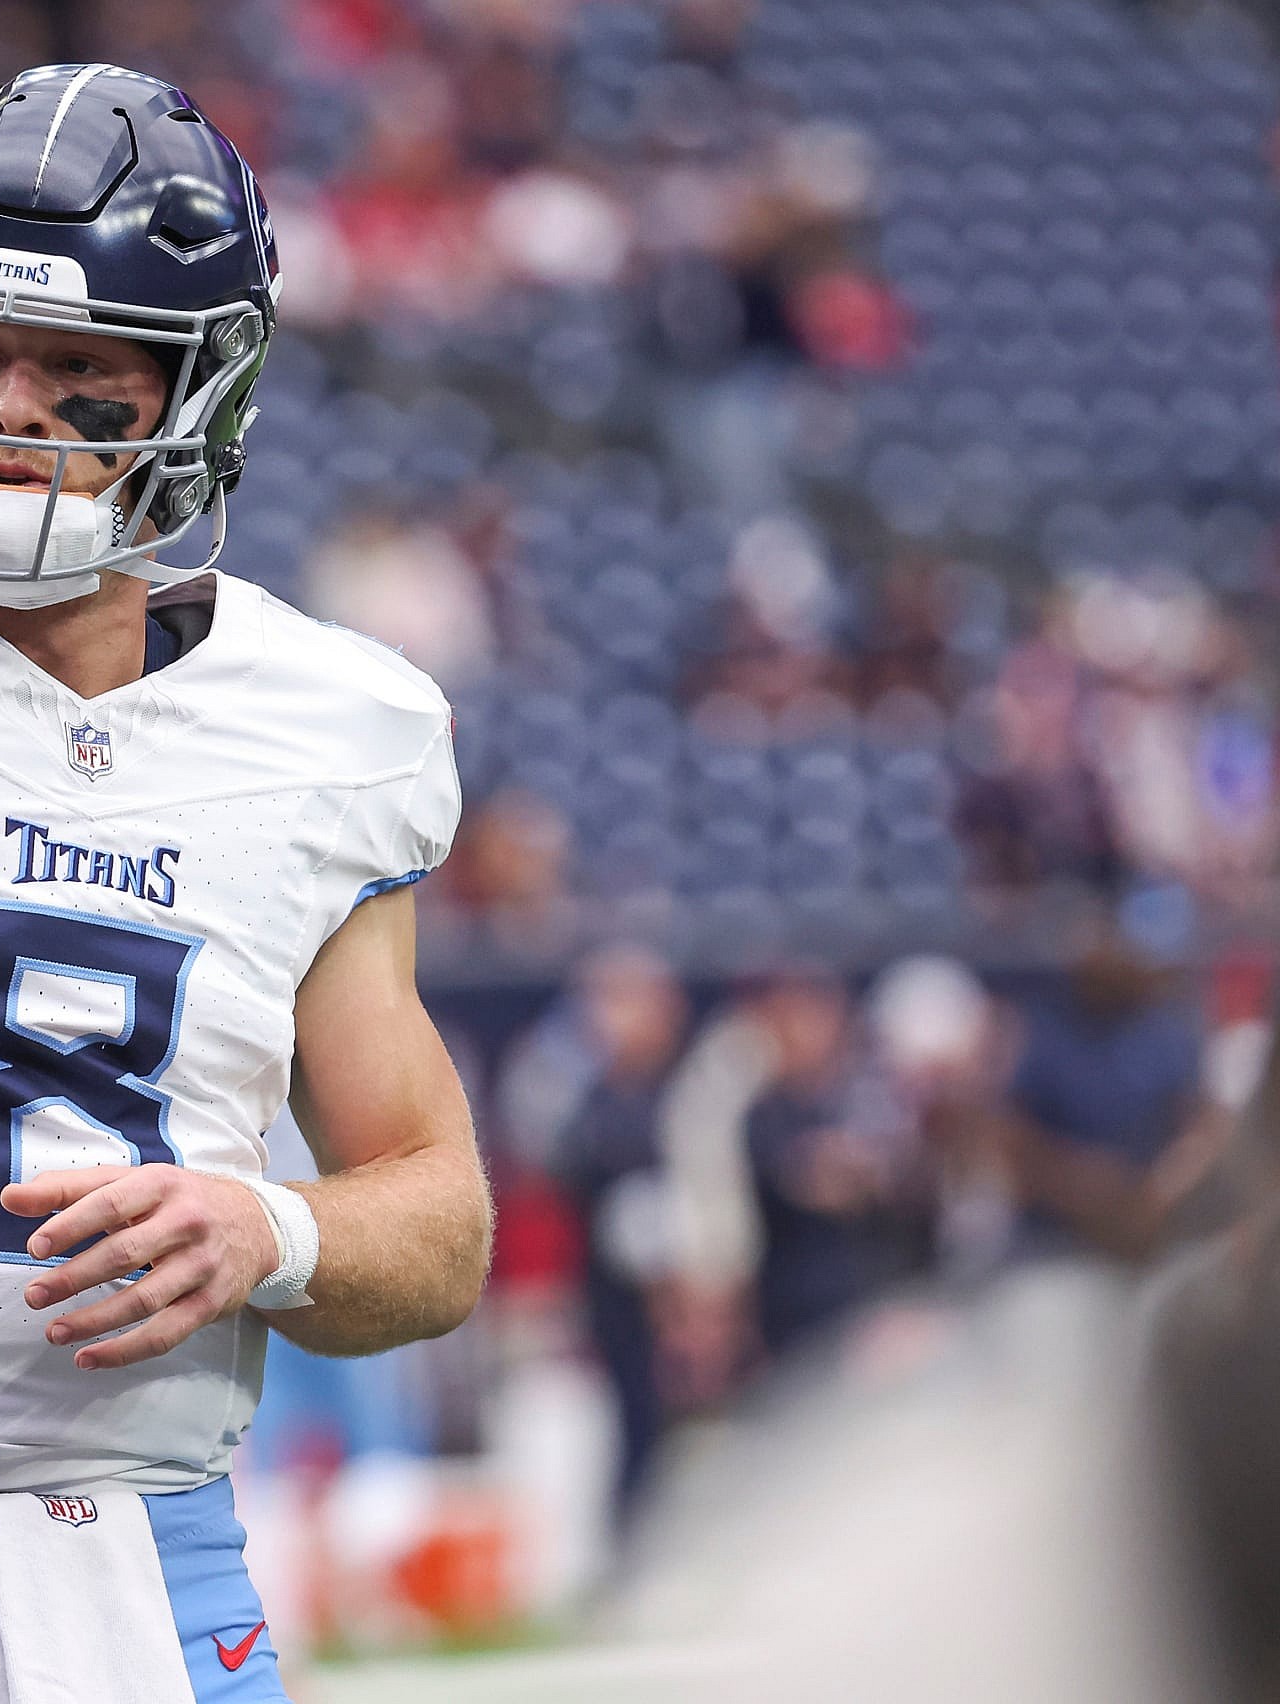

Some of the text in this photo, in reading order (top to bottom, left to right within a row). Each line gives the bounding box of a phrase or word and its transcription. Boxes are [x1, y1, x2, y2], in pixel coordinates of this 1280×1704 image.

[76, 743, 109, 768] NFL
[5, 816, 181, 908] TITANS
[48, 1499, 93, 1520] NFL
